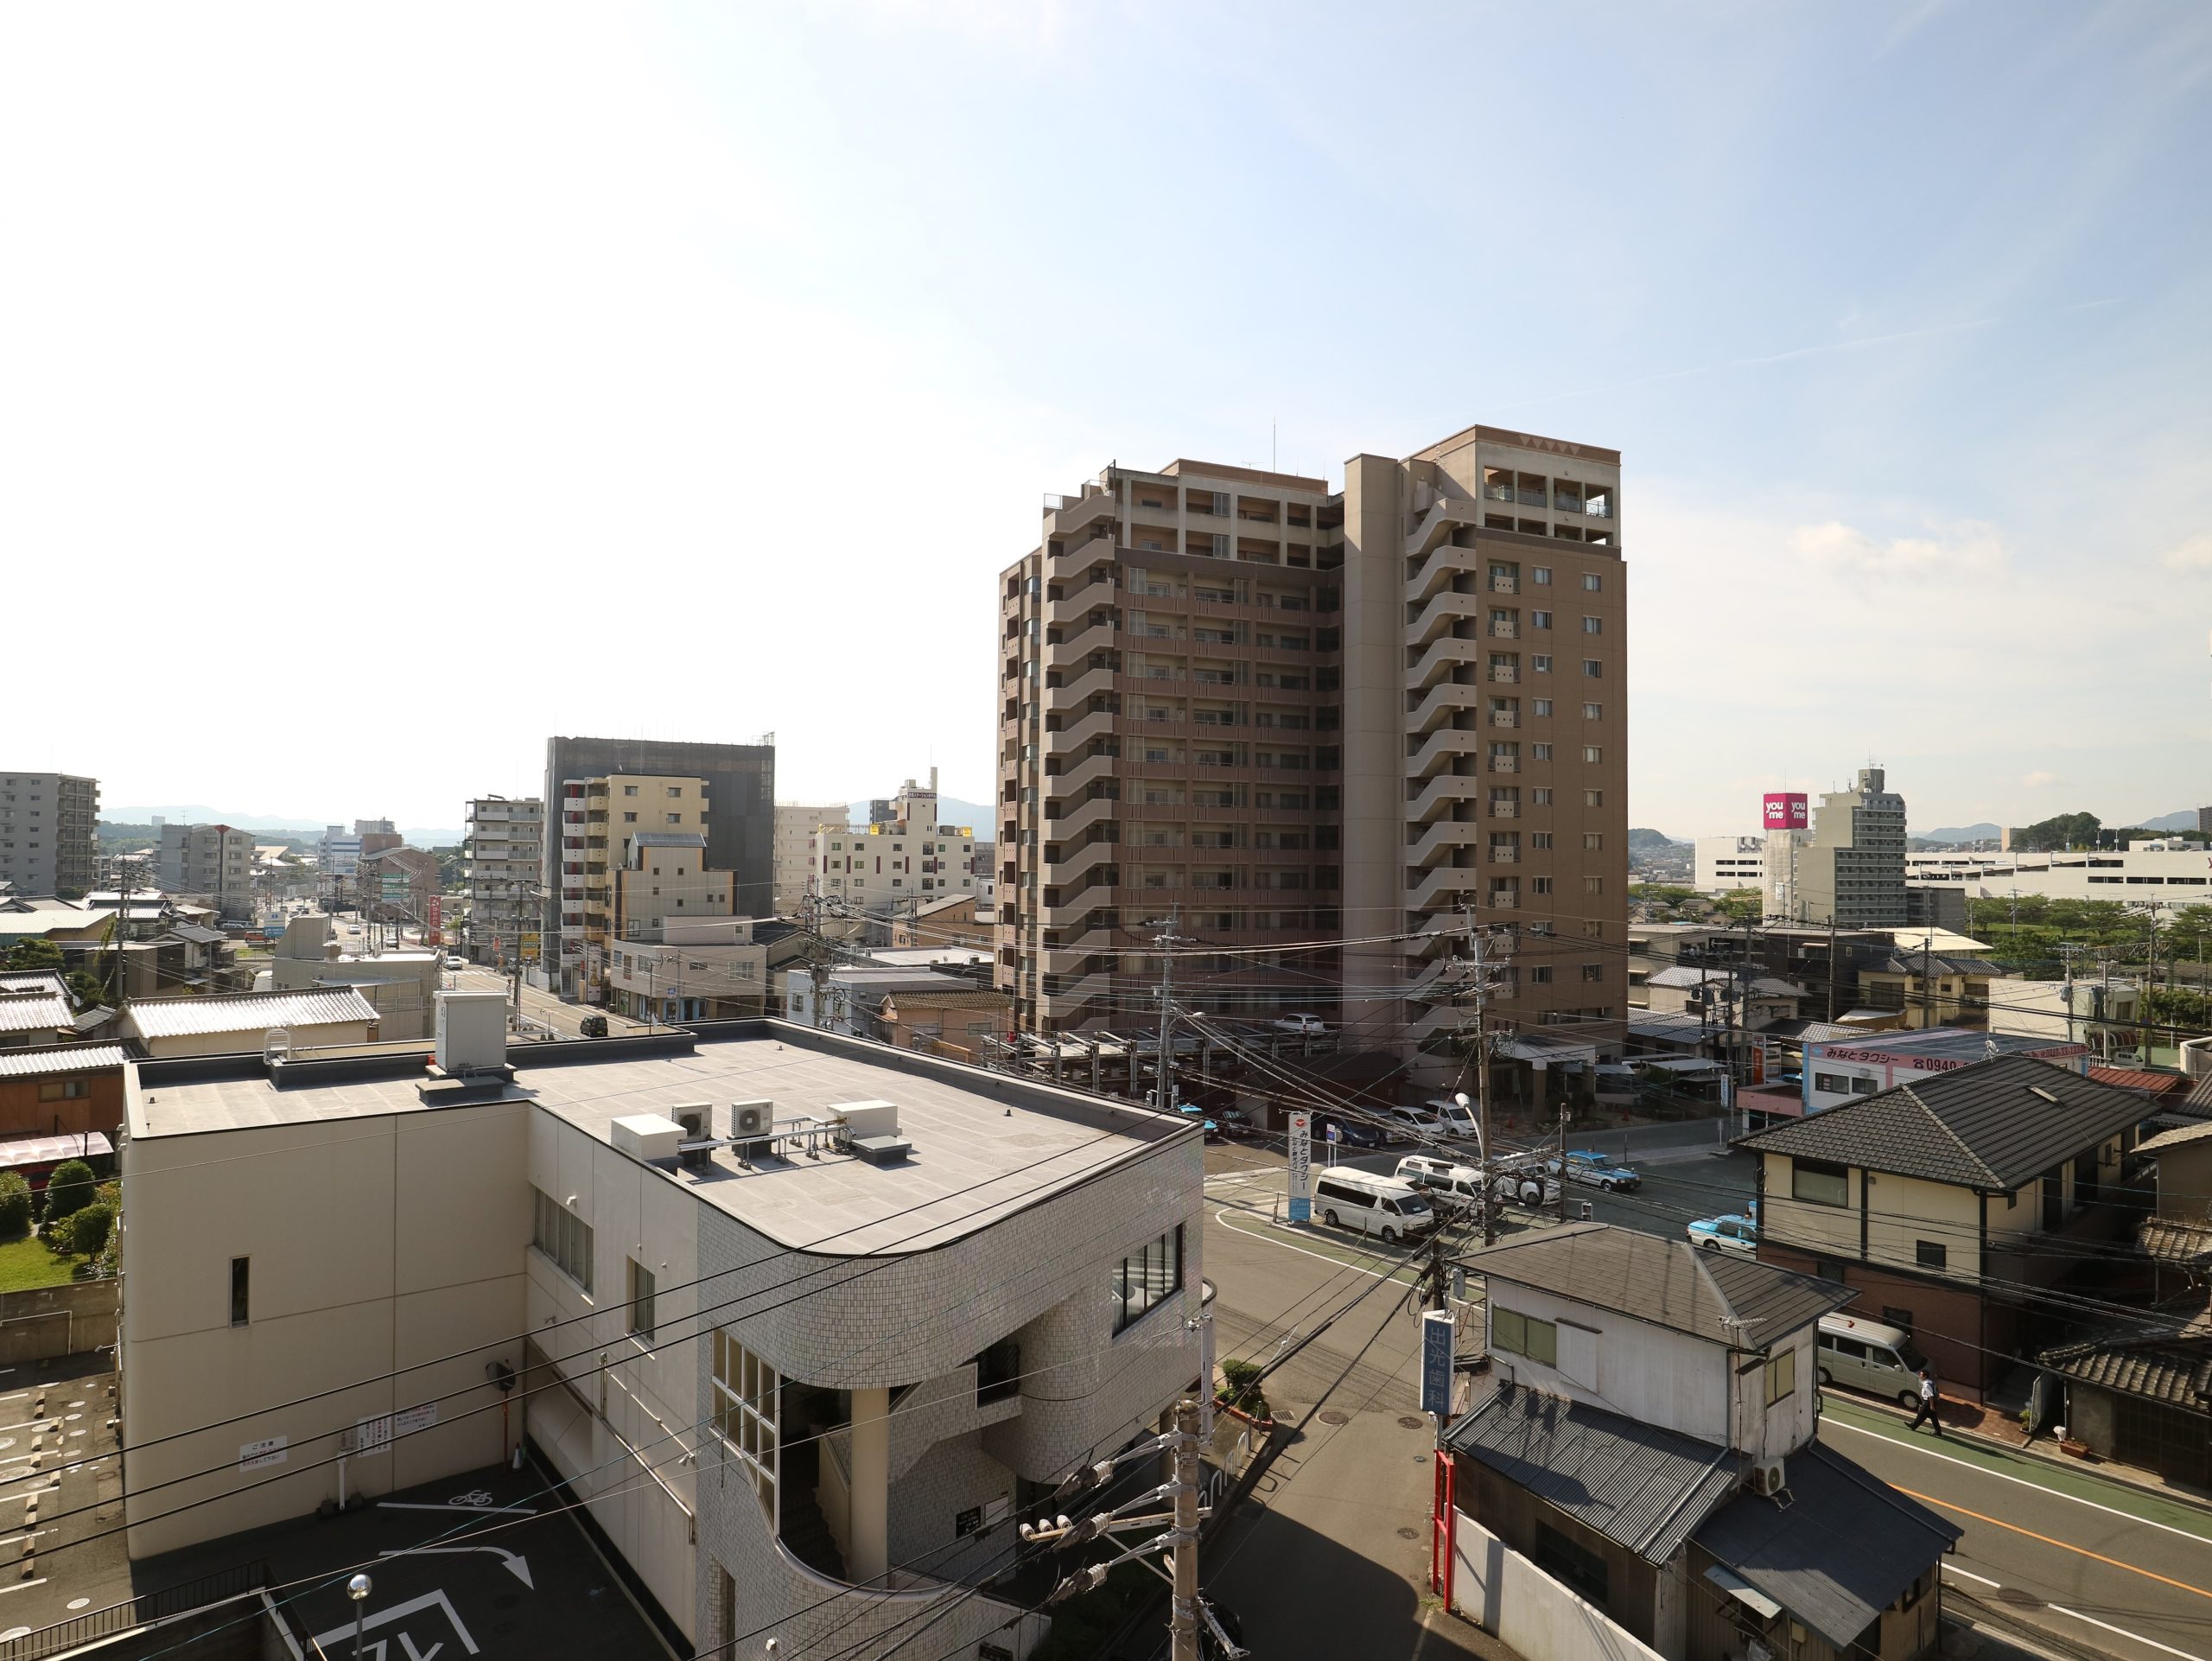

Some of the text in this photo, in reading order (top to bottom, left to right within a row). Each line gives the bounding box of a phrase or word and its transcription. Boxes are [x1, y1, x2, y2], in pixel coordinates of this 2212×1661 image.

[1765, 801, 1783, 813] you
[1791, 801, 1806, 813] you
[1827, 1047, 1899, 1064] みなとタクシー
[1300, 1130, 1308, 1191] みなとタクシー
[1427, 1327, 1446, 1410] 出光歯科
